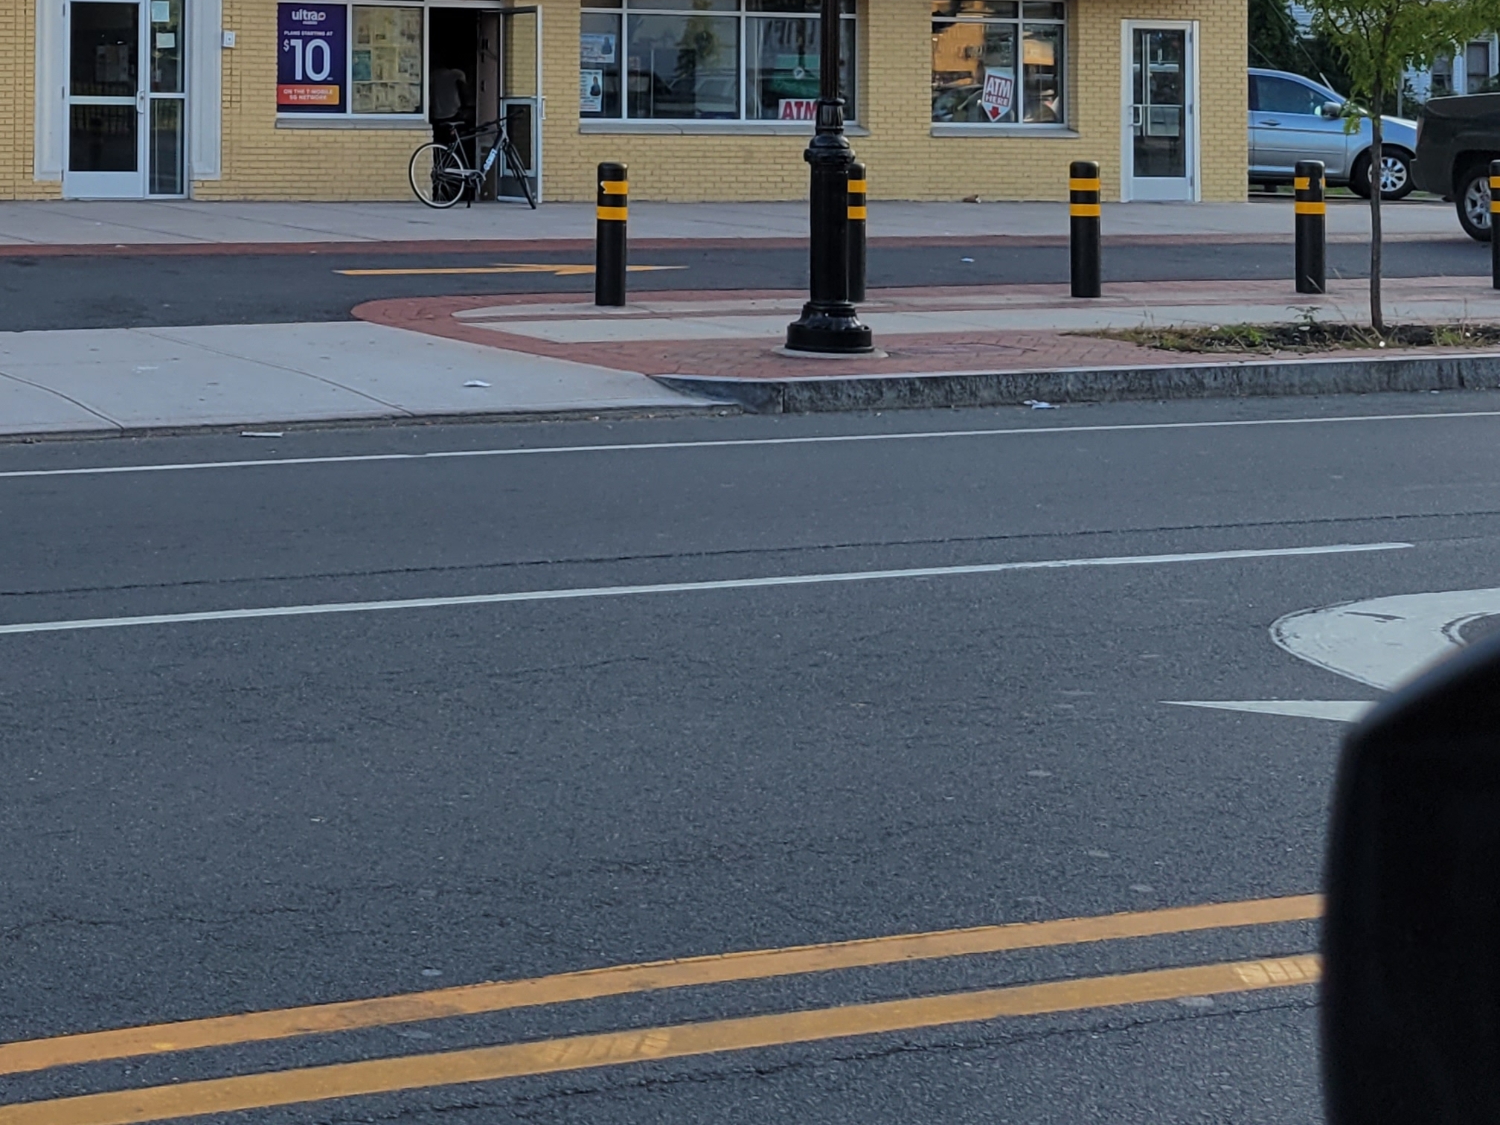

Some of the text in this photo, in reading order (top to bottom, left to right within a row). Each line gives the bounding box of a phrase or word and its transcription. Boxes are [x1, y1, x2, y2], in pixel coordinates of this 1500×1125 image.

[291, 8, 318, 21] ultra
[283, 38, 331, 82] $10
[985, 77, 1012, 98] ATM
[985, 95, 1009, 106] HERE
[782, 101, 817, 120] ATM
